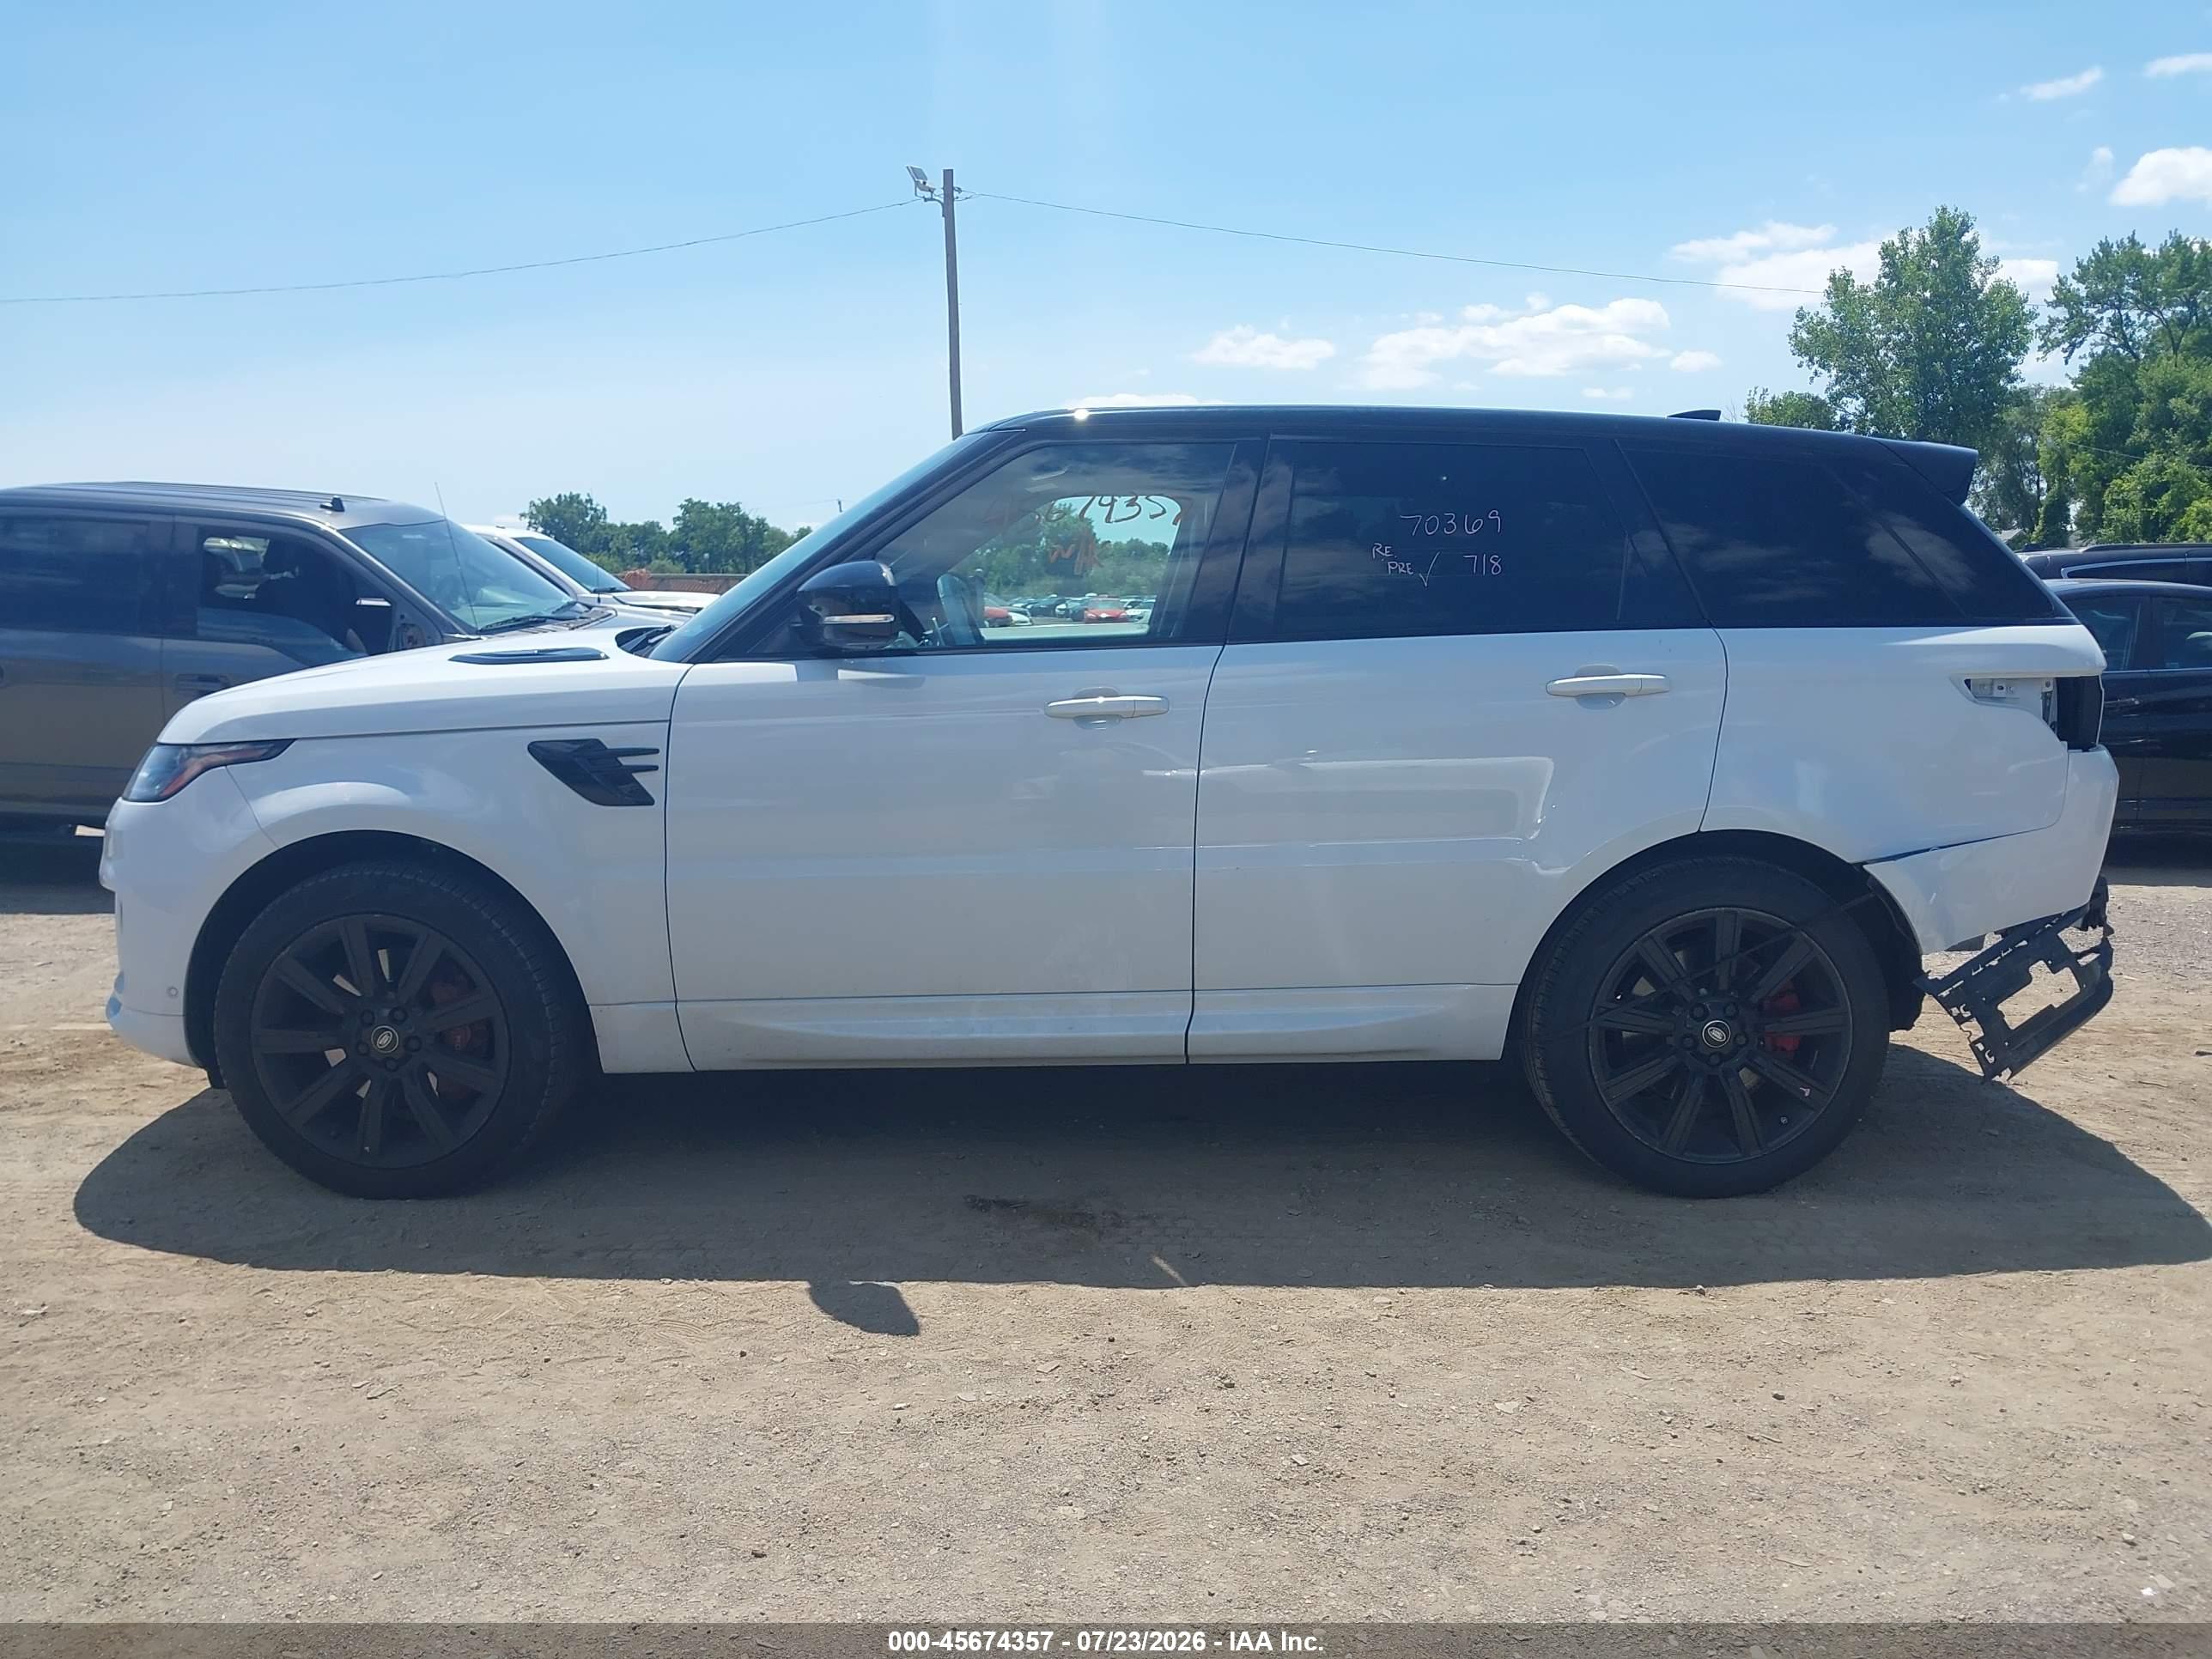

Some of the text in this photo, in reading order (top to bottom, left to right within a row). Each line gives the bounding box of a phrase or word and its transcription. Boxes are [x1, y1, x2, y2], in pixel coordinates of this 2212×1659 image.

[1400, 509, 1502, 537] 70369
[1387, 553, 1503, 575] PRE 718
